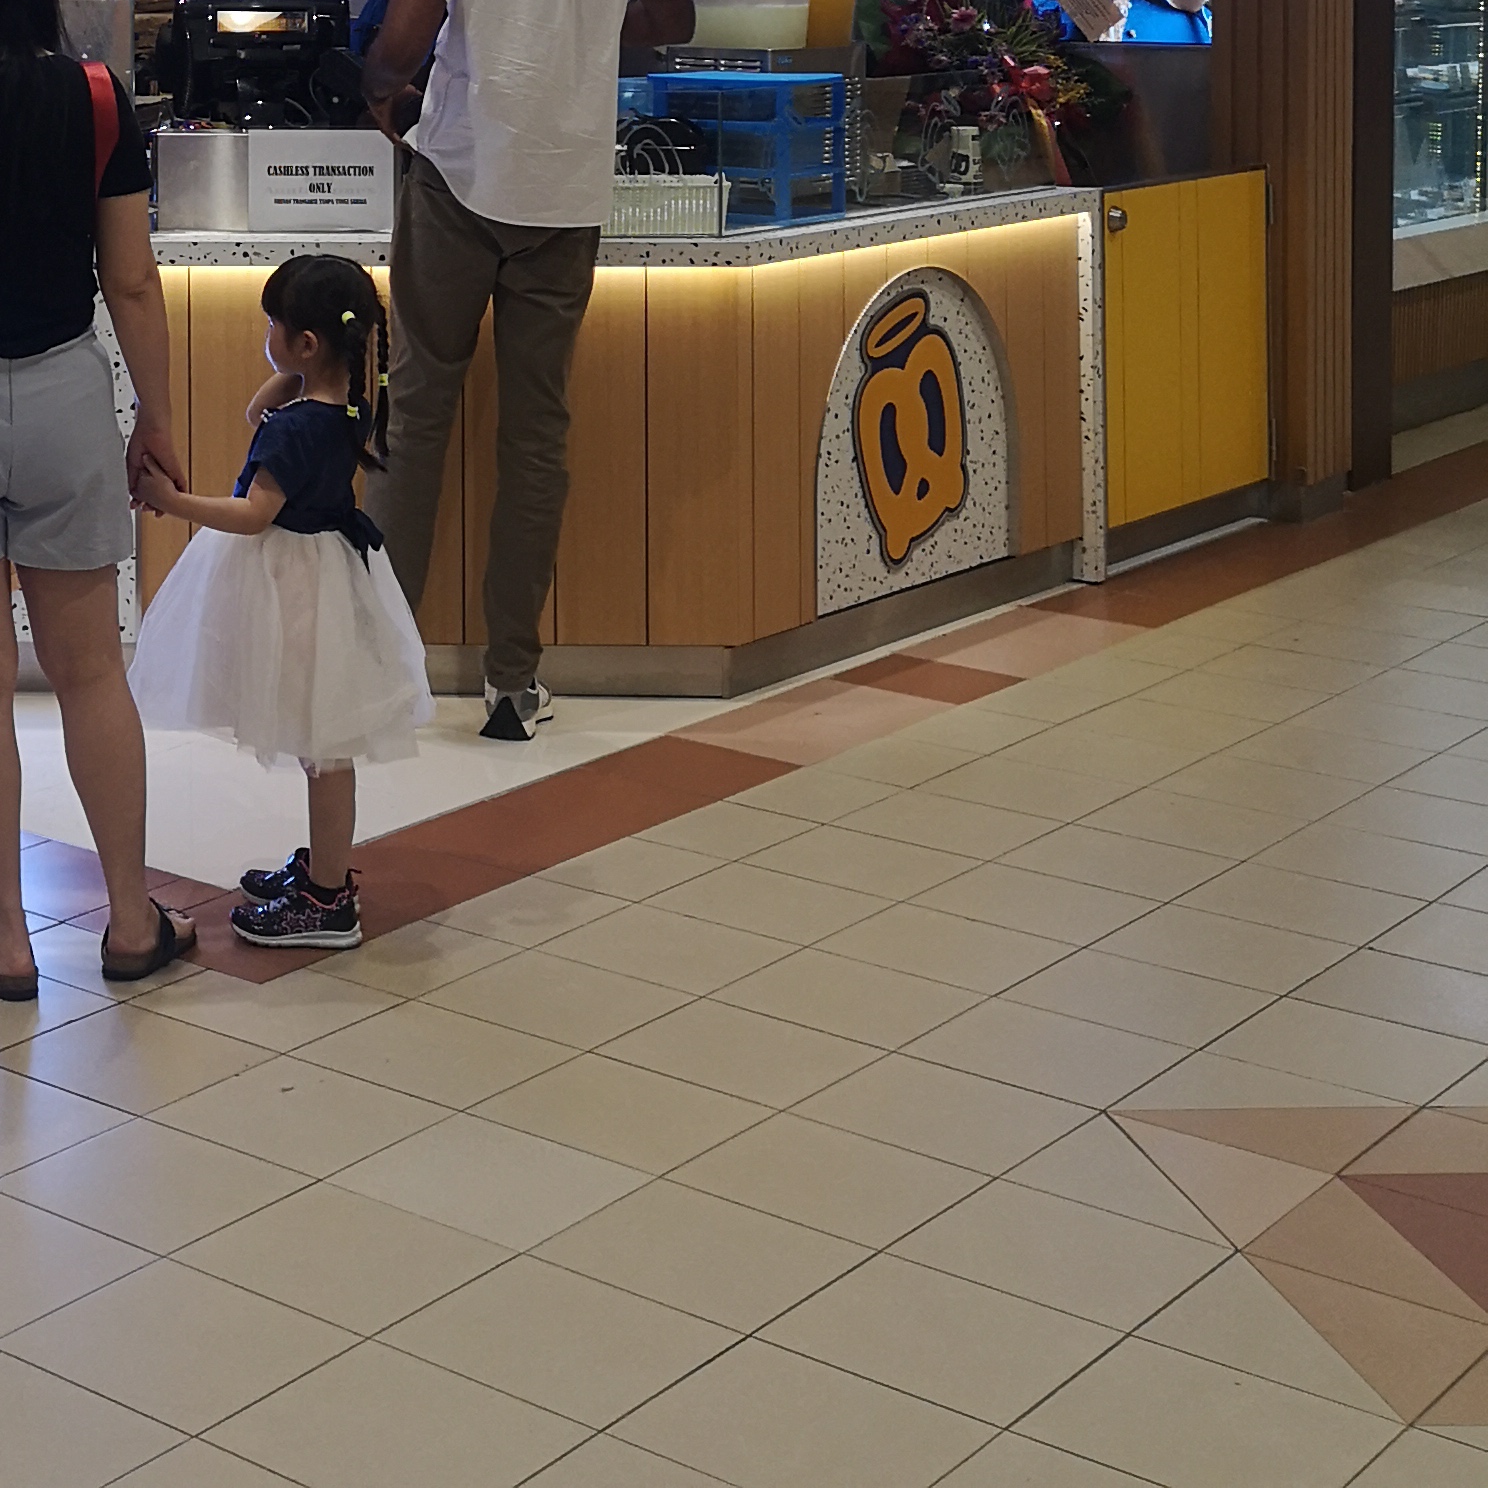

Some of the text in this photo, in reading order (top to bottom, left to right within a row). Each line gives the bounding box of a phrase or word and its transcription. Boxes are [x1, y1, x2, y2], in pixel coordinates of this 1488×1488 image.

[267, 165, 375, 177] CASHLESS TRANSACTION
[308, 182, 333, 194] ONLY
